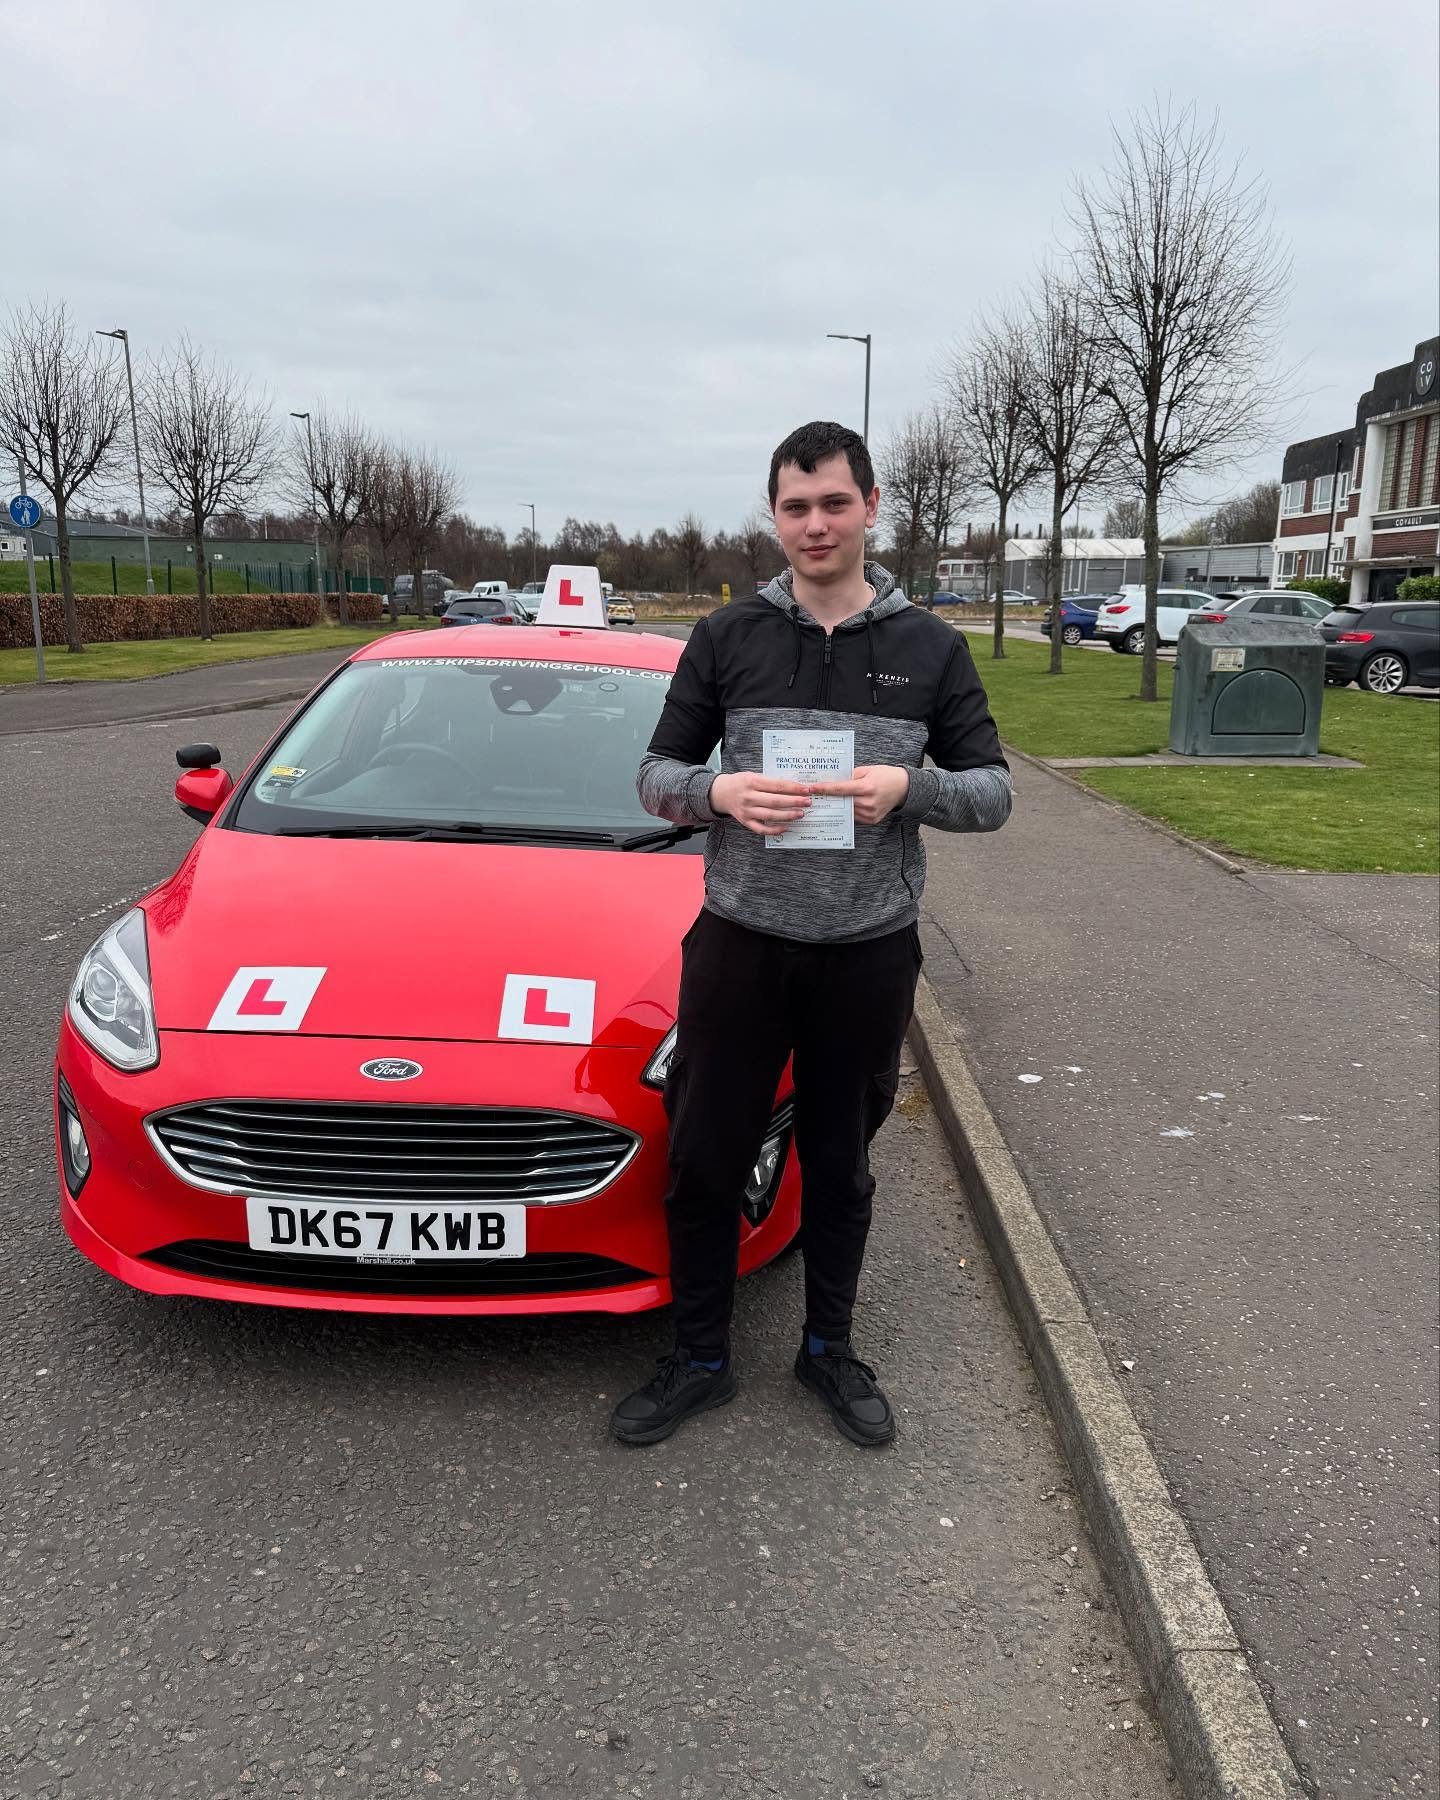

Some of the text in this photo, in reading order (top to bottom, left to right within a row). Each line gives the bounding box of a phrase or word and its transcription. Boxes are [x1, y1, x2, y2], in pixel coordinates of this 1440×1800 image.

[1420, 361, 1433, 375] CO
[559, 579, 584, 606] L
[866, 672, 909, 683] MKENZIE
[236, 978, 288, 1015] L
[523, 987, 571, 1027] L
[373, 1062, 409, 1076] Ford
[267, 1205, 506, 1251] DK67 KWB
[356, 1256, 416, 1265] Marshall.co.uk
